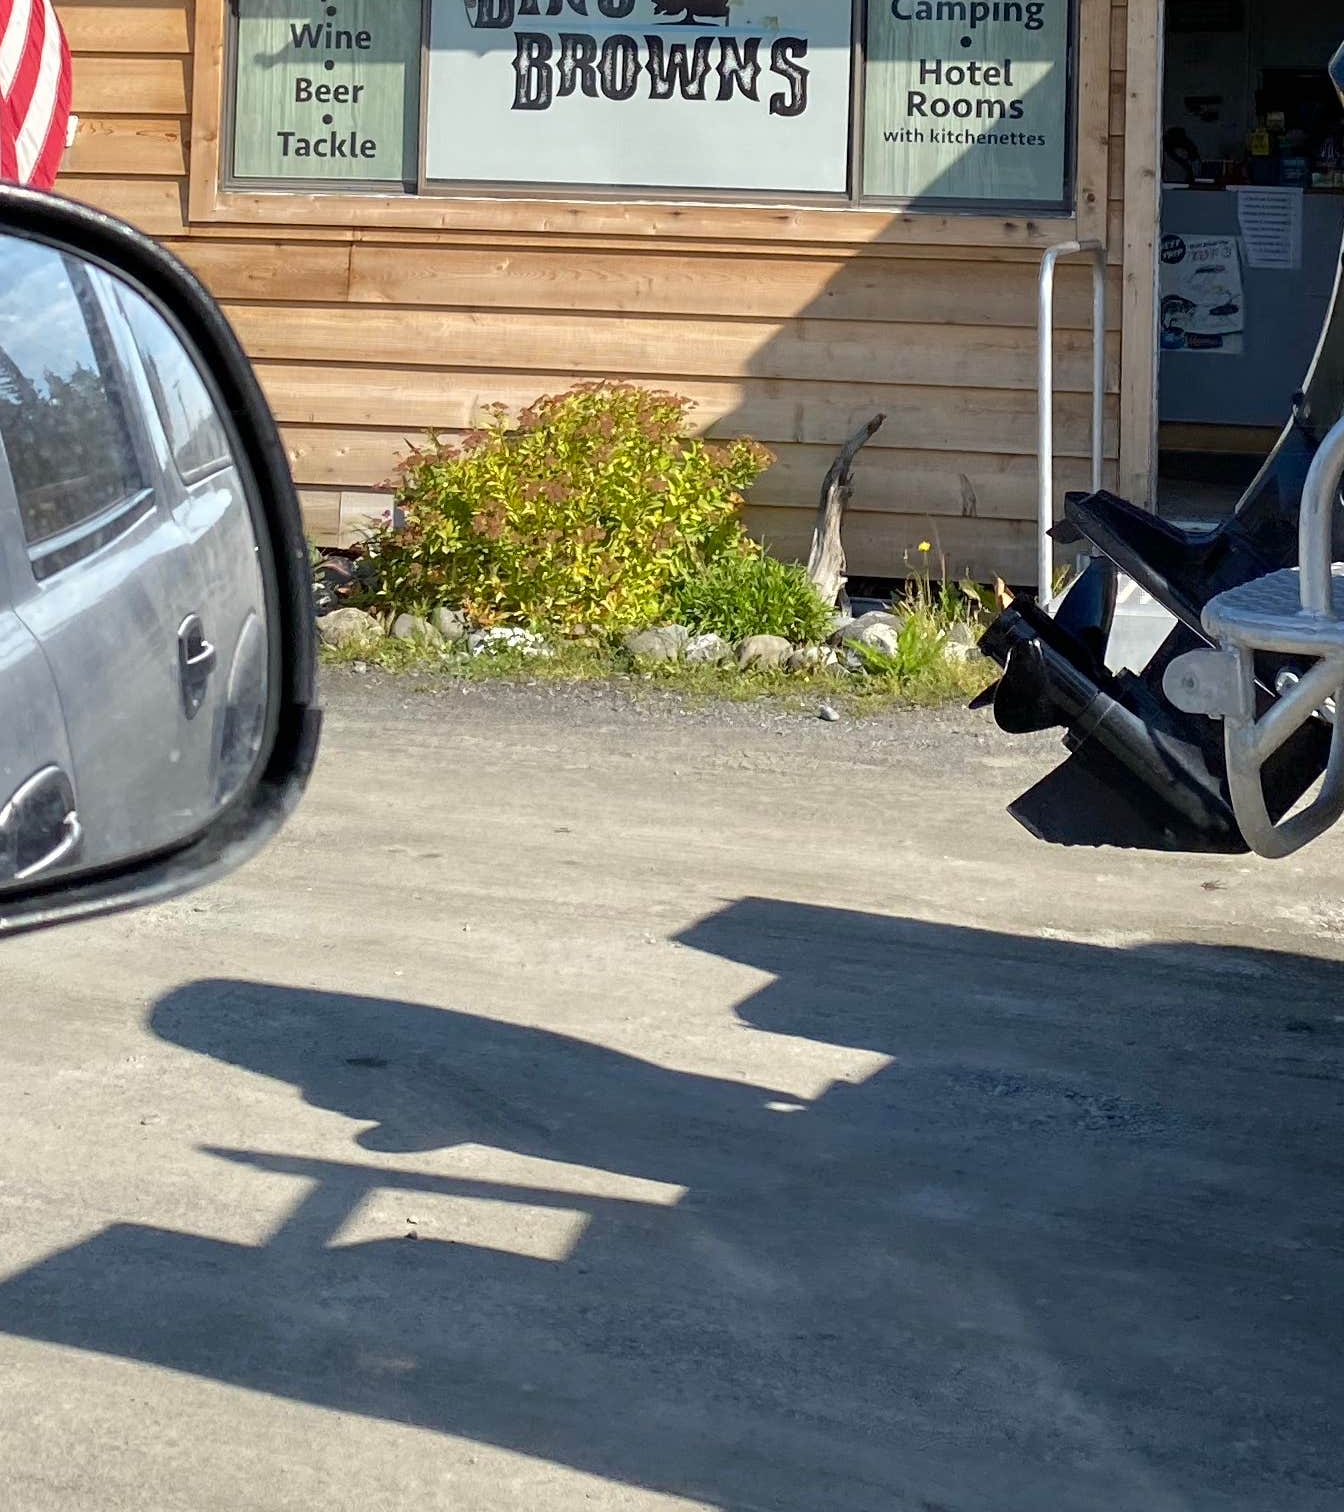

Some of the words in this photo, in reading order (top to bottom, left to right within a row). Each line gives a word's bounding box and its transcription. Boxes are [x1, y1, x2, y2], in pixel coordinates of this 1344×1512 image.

[290, 22, 372, 50] Wine
[511, 31, 810, 117] BROWNS
[919, 59, 1014, 87] Hotel
[294, 78, 365, 104] Beer
[906, 91, 1025, 120] Rooms
[277, 131, 377, 159] Tackle
[883, 128, 924, 145] with
[929, 128, 1046, 147] kitchenettes
